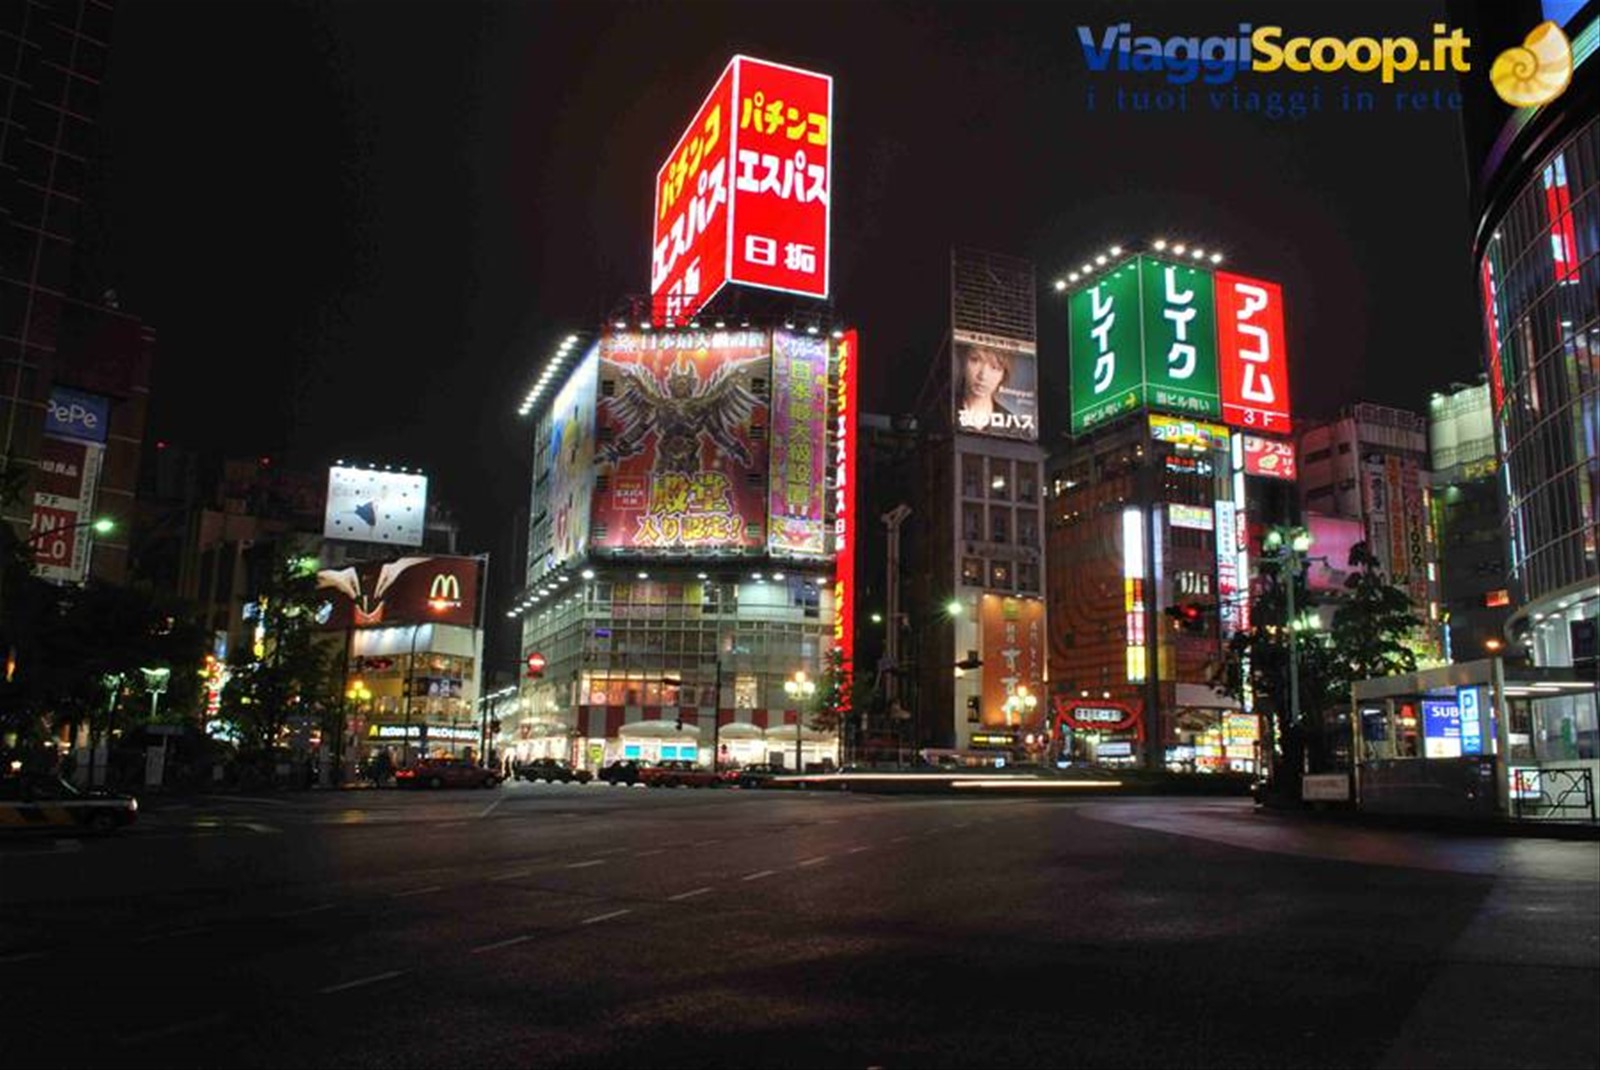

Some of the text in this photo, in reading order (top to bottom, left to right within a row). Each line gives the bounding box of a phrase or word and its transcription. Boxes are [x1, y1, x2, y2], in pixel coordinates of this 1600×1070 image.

[741, 91, 827, 146] パチンコ
[660, 104, 721, 221] パチンコ
[736, 149, 828, 206] エスパス
[652, 157, 726, 294] エスパス
[745, 235, 816, 274] 日拓
[1087, 285, 1115, 394] レイク
[1164, 267, 1197, 379] レイク
[1235, 283, 1275, 403] アコム
[30, 533, 66, 559] LO
[1432, 706, 1459, 718] SUB
